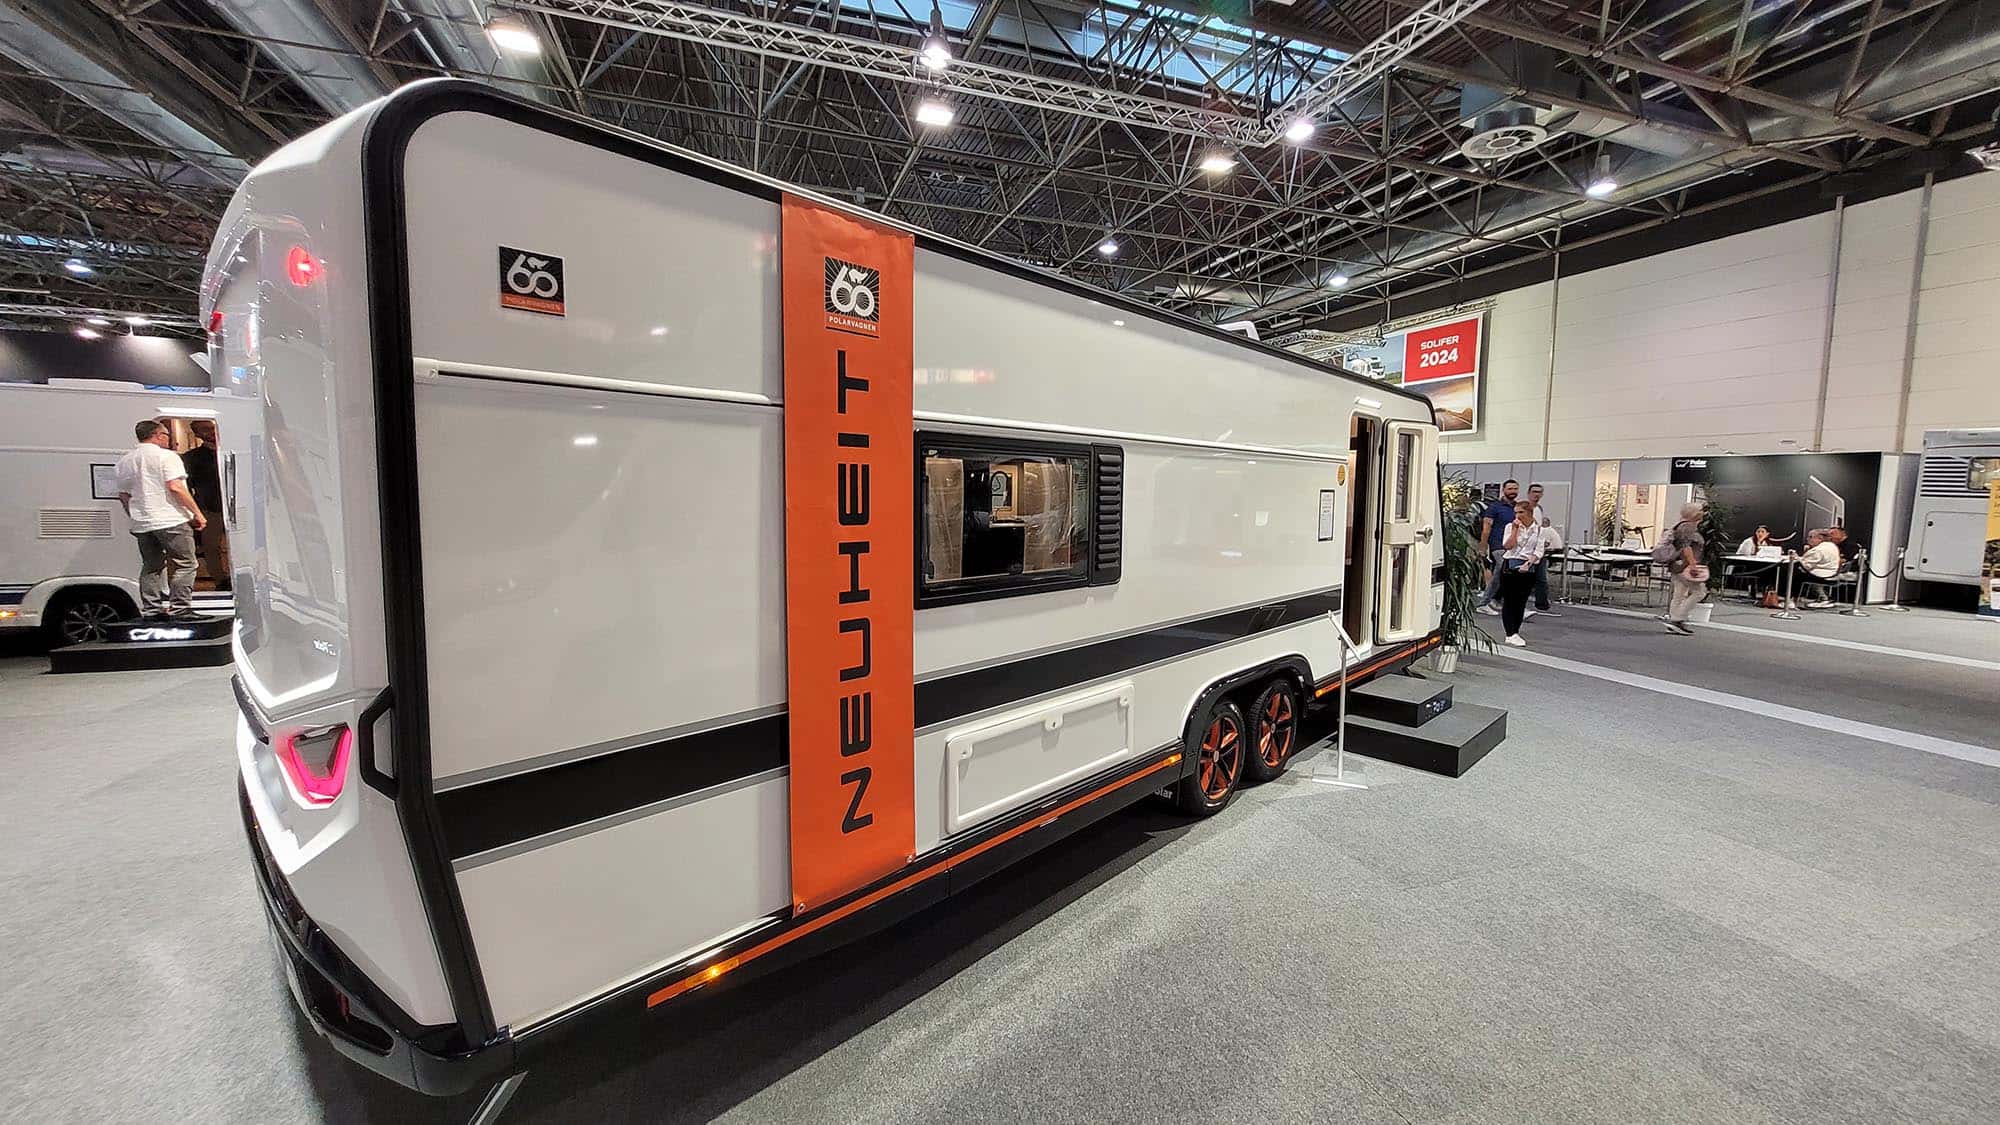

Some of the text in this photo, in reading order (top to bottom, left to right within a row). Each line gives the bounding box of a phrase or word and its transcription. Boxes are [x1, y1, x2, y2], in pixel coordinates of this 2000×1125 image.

[829, 316, 877, 332] POLARVAGNEN
[1420, 335, 1459, 350] SOLIFER
[1420, 347, 1458, 368] 2024
[837, 350, 873, 834] NEUHEIT
